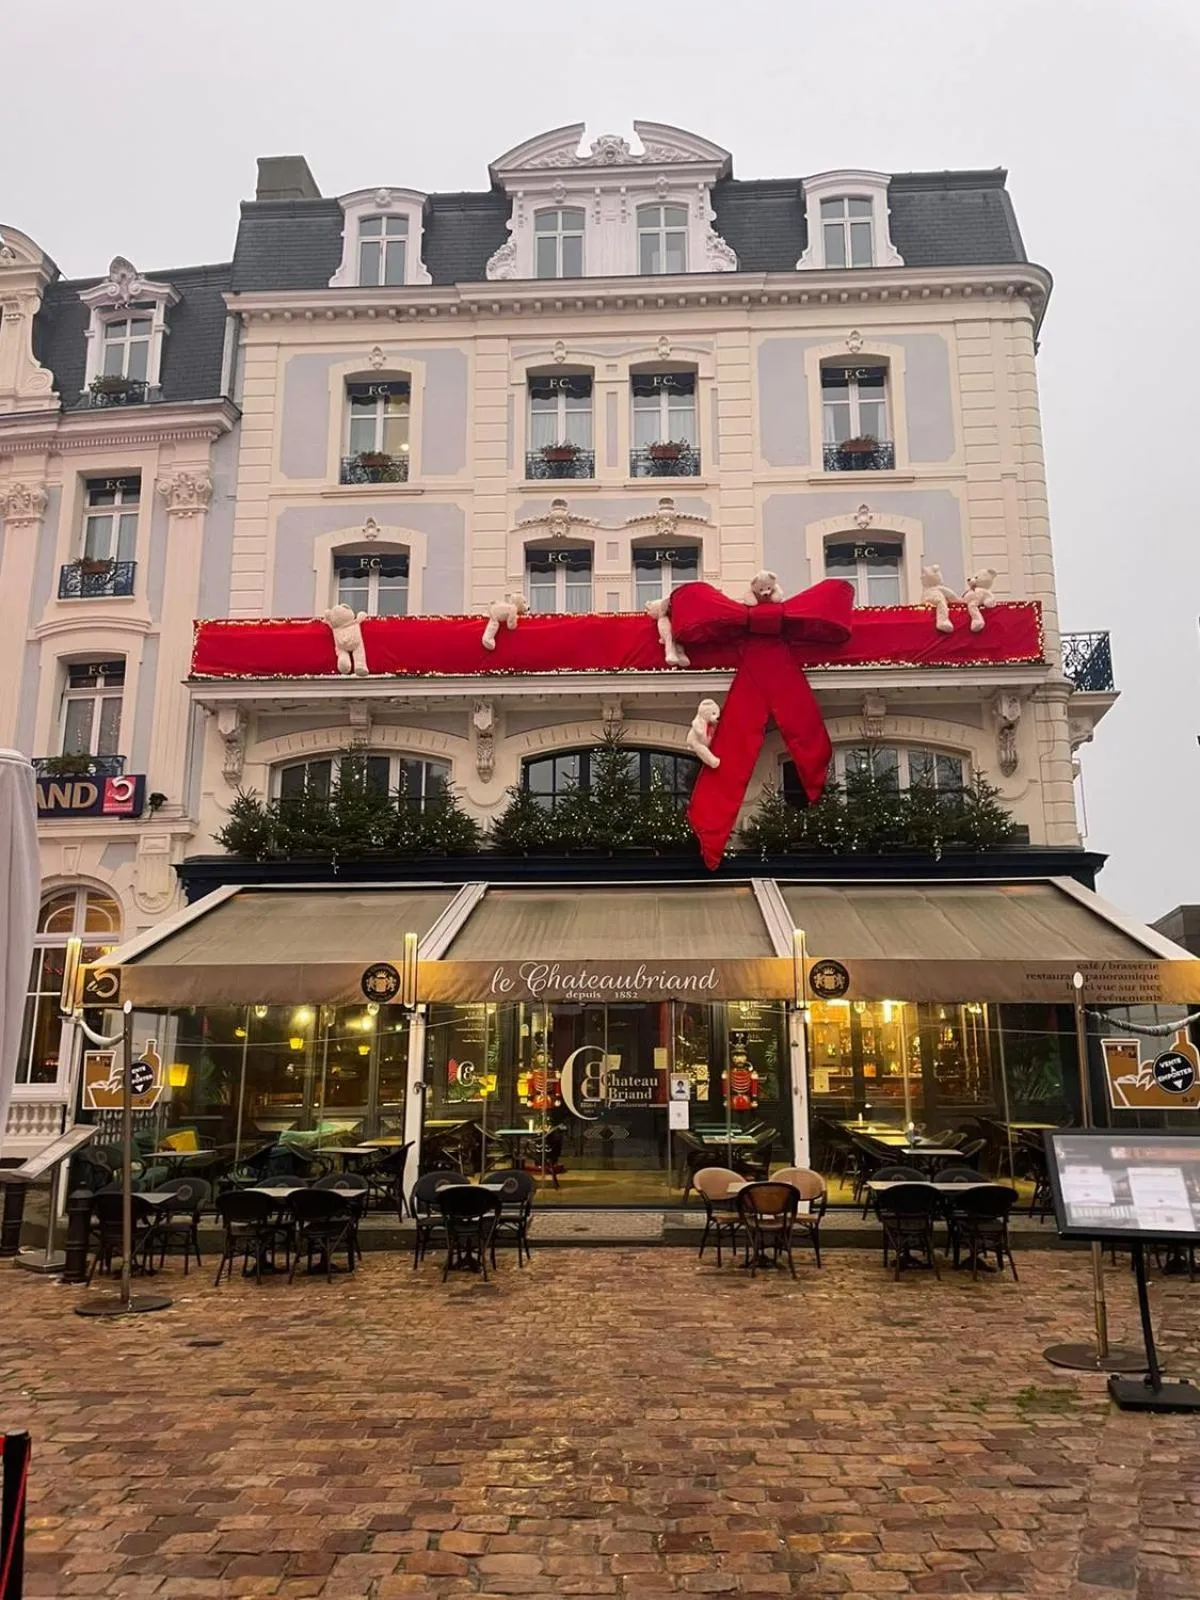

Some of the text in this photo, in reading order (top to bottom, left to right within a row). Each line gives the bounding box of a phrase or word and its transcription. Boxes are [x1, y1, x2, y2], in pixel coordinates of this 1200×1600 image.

[491, 961, 719, 997] le Chateaubriand
[565, 990, 601, 1000] depuis
[602, 1073, 658, 1087] Chateau
[608, 1087, 652, 1100] Briand
